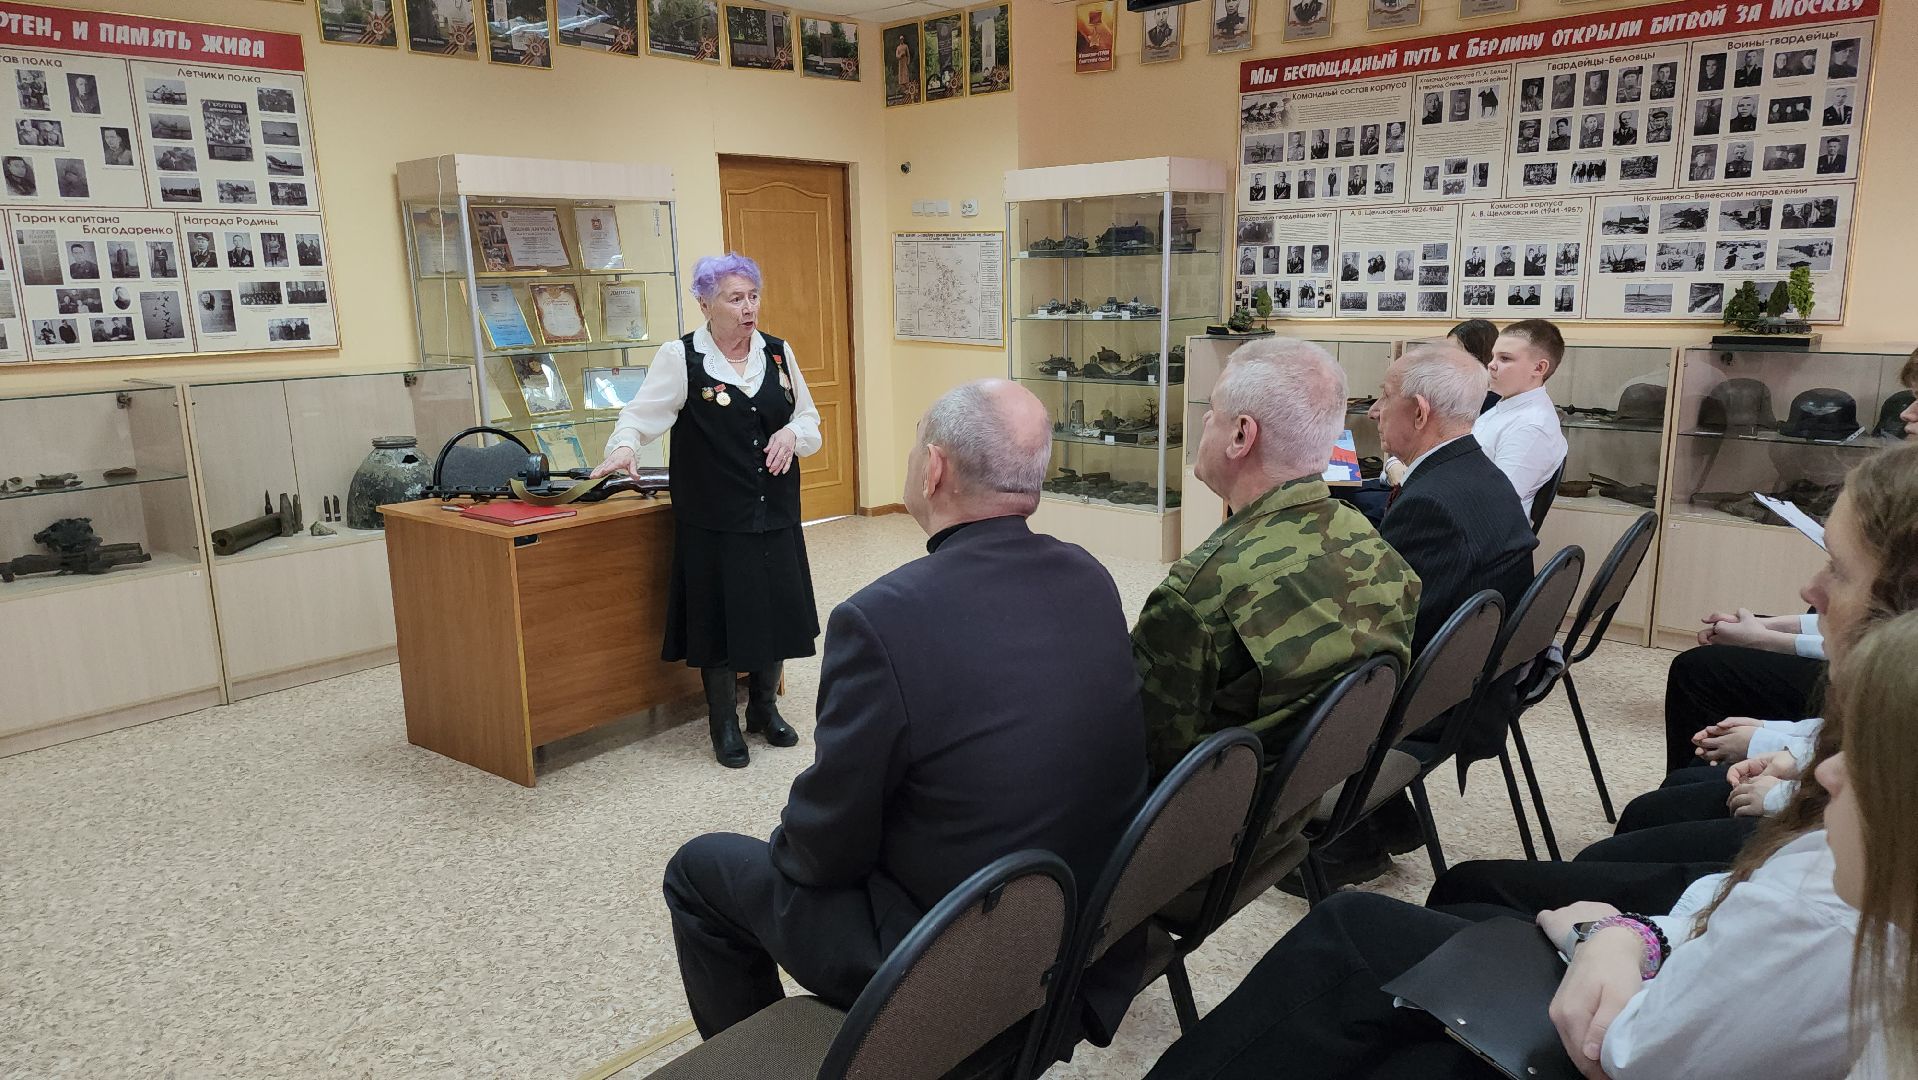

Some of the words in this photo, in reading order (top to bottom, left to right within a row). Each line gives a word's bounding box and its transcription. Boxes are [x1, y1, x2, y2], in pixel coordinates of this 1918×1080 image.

[72, 21, 89, 41] И
[99, 23, 192, 51] ПАМЯТЬ
[200, 33, 265, 59] ЖИВА
[1727, 31, 1839, 50] Воины-гвардейцы
[22, 56, 63, 67] полка
[1547, 52, 1656, 71] Гвардейцы-Беловцы
[177, 68, 225, 81] Летчики
[227, 73, 262, 84] полка
[1292, 87, 1338, 101] Командный
[1339, 85, 1369, 96] состав
[1370, 81, 1407, 92] корпуса
[1633, 195, 1645, 203] На
[1745, 187, 1808, 198] направлении
[1490, 202, 1529, 210] Комиссар
[1530, 200, 1564, 209] корпуса
[15, 213, 57, 225] Таран
[59, 215, 120, 224] капитана
[183, 215, 234, 227] Награда
[236, 216, 279, 227] Родины
[82, 225, 174, 236] Благодаренко
